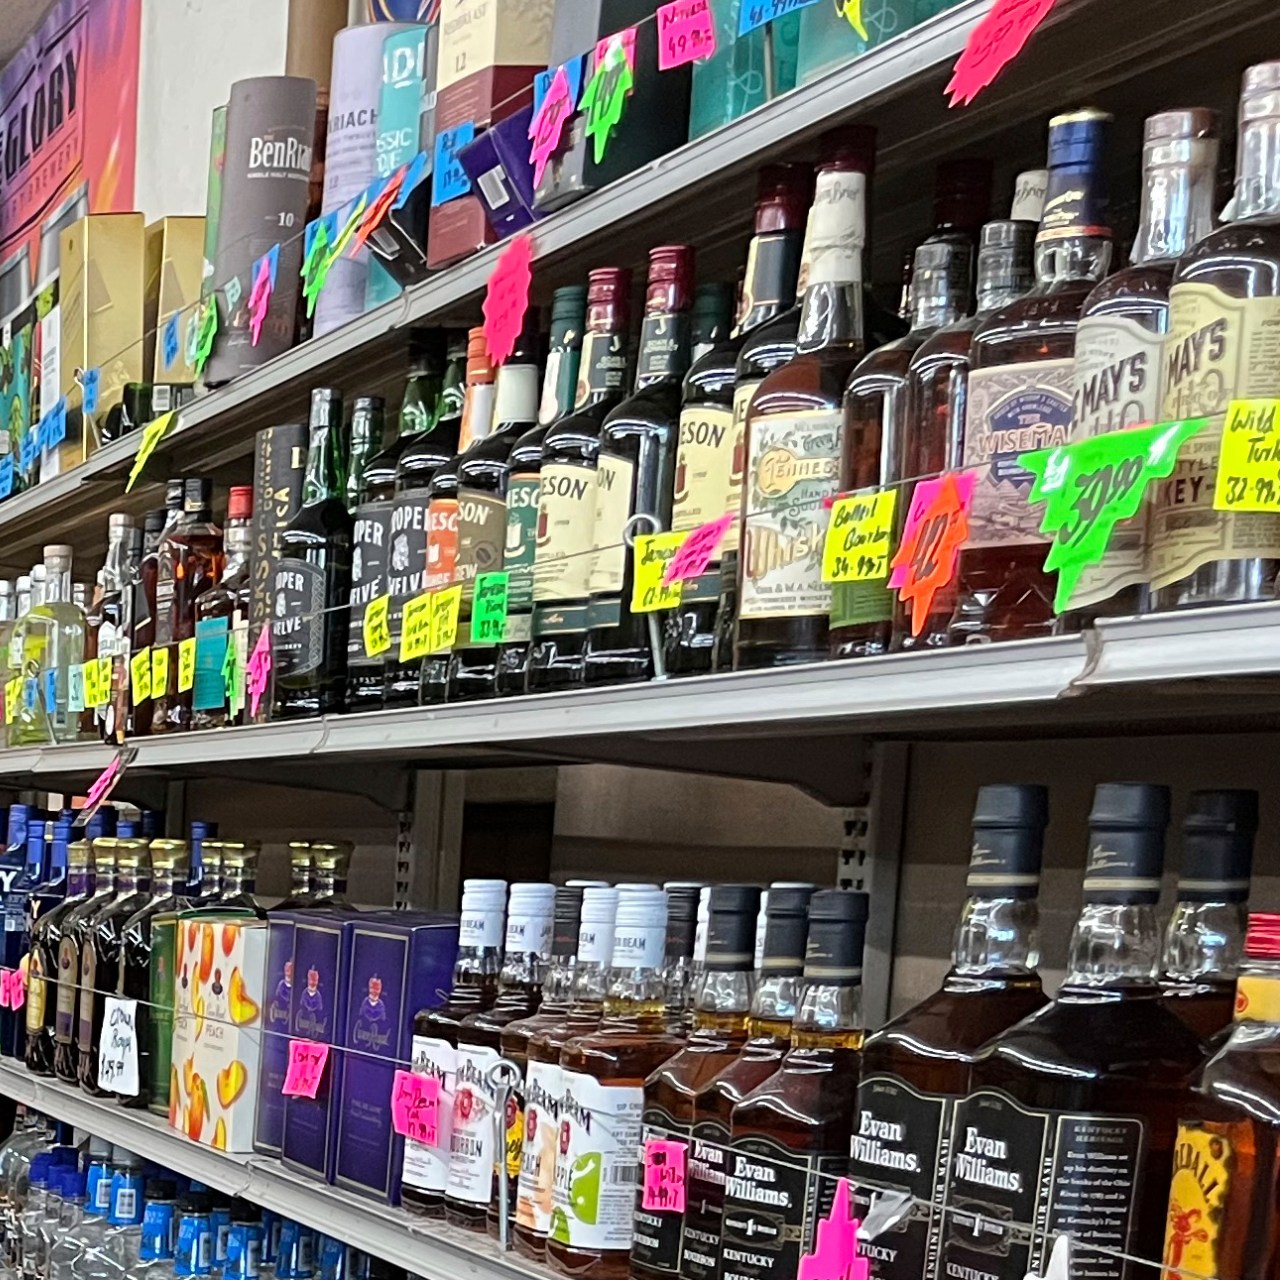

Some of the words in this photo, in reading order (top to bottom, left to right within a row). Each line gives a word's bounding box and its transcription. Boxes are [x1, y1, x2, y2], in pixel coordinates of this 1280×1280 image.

[5, 45, 82, 182] GLORY
[278, 212, 295, 227] 10
[859, 1110, 903, 1142] Evan
[965, 1126, 1007, 1160] Evan
[733, 1155, 776, 1183] Evan
[849, 1134, 922, 1174] Williams.
[939, 1138, 950, 1179] MASH
[954, 1152, 1024, 1195] Williams.
[1040, 1157, 1053, 1199] MASH
[724, 1175, 793, 1209] Williams.
[723, 1247, 775, 1269] KENTUCKY
